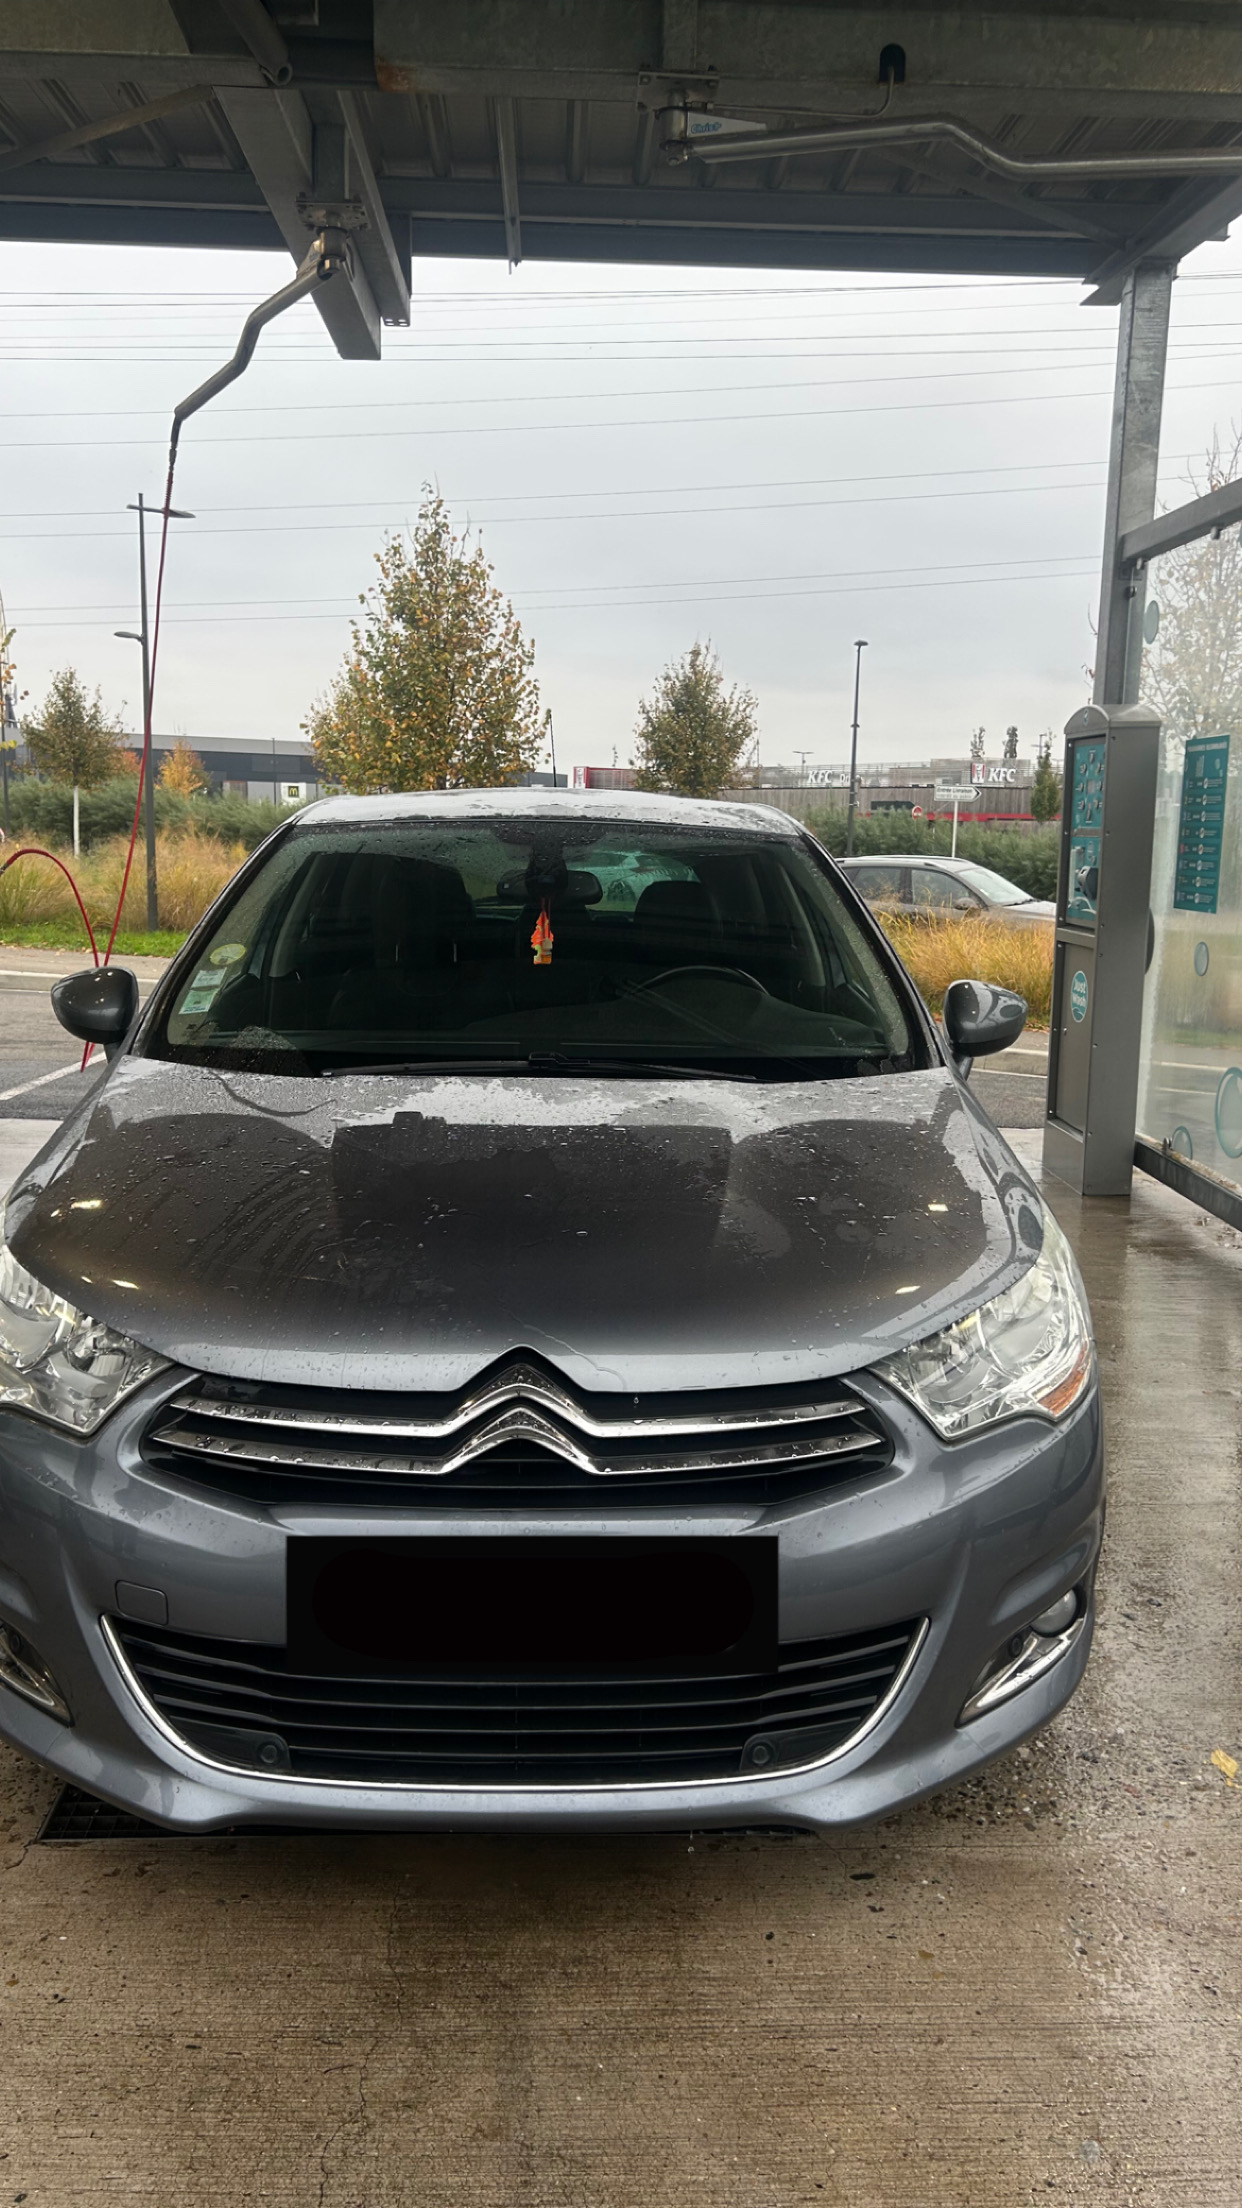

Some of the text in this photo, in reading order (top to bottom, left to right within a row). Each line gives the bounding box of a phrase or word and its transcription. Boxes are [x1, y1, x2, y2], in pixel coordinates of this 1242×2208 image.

[807, 770, 832, 783] KFC
[988, 768, 1017, 782] KFC
[1074, 979, 1086, 994] Just
